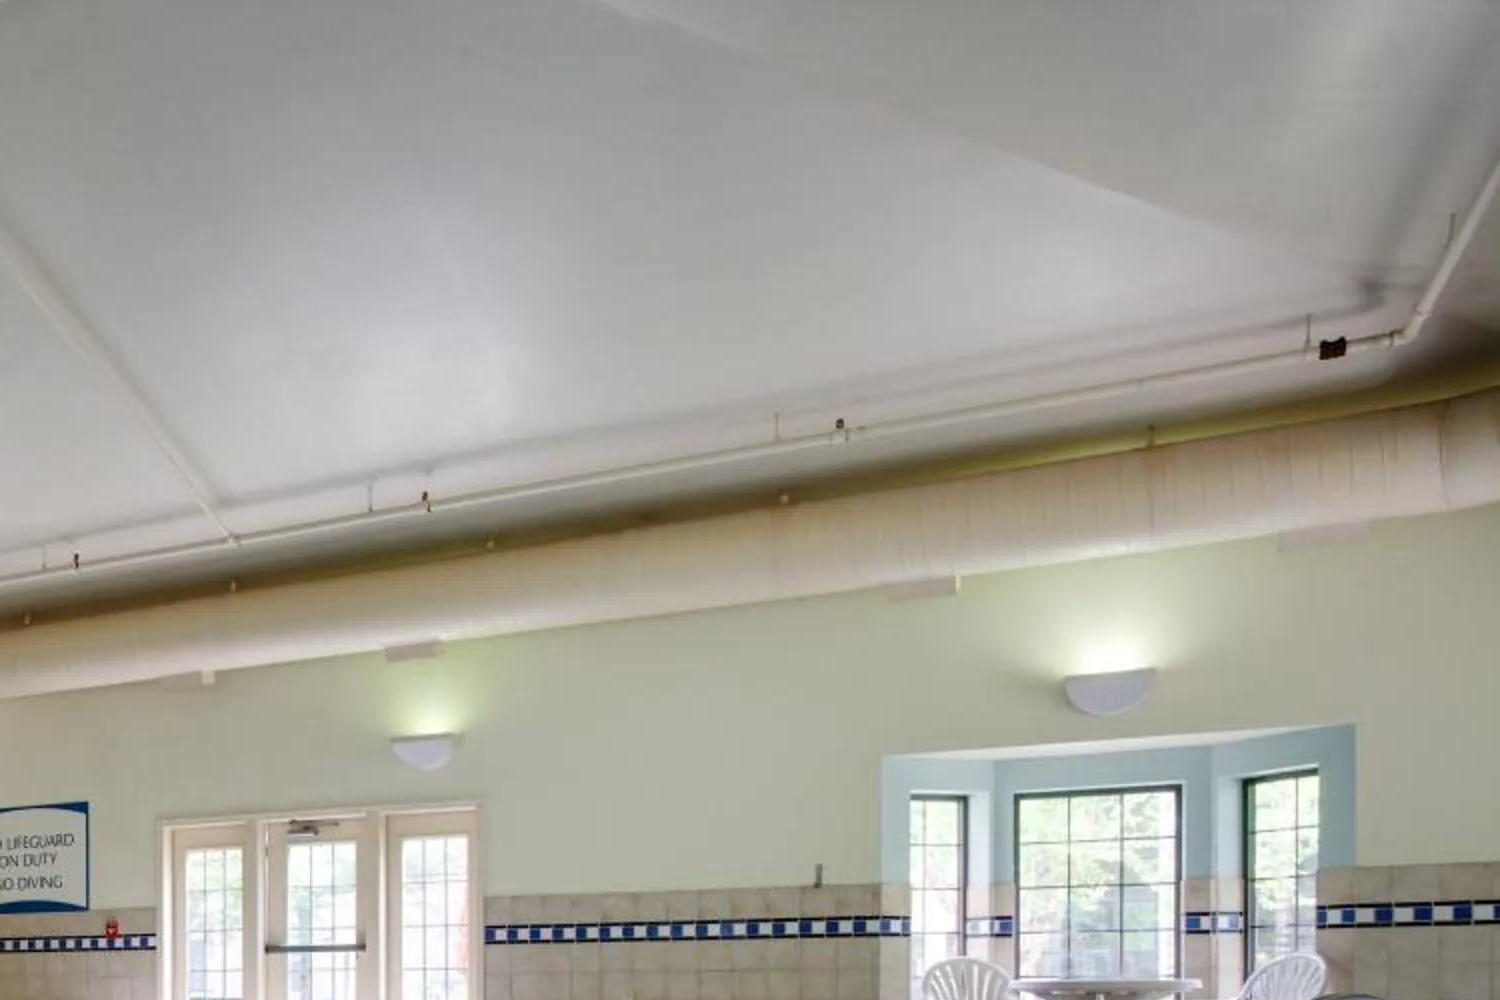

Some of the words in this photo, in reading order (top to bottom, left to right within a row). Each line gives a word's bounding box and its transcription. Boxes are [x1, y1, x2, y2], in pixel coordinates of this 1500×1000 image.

[6, 833, 75, 850] LIFEGUARD
[23, 851, 58, 867] DUTY
[17, 875, 63, 891] DIVING
